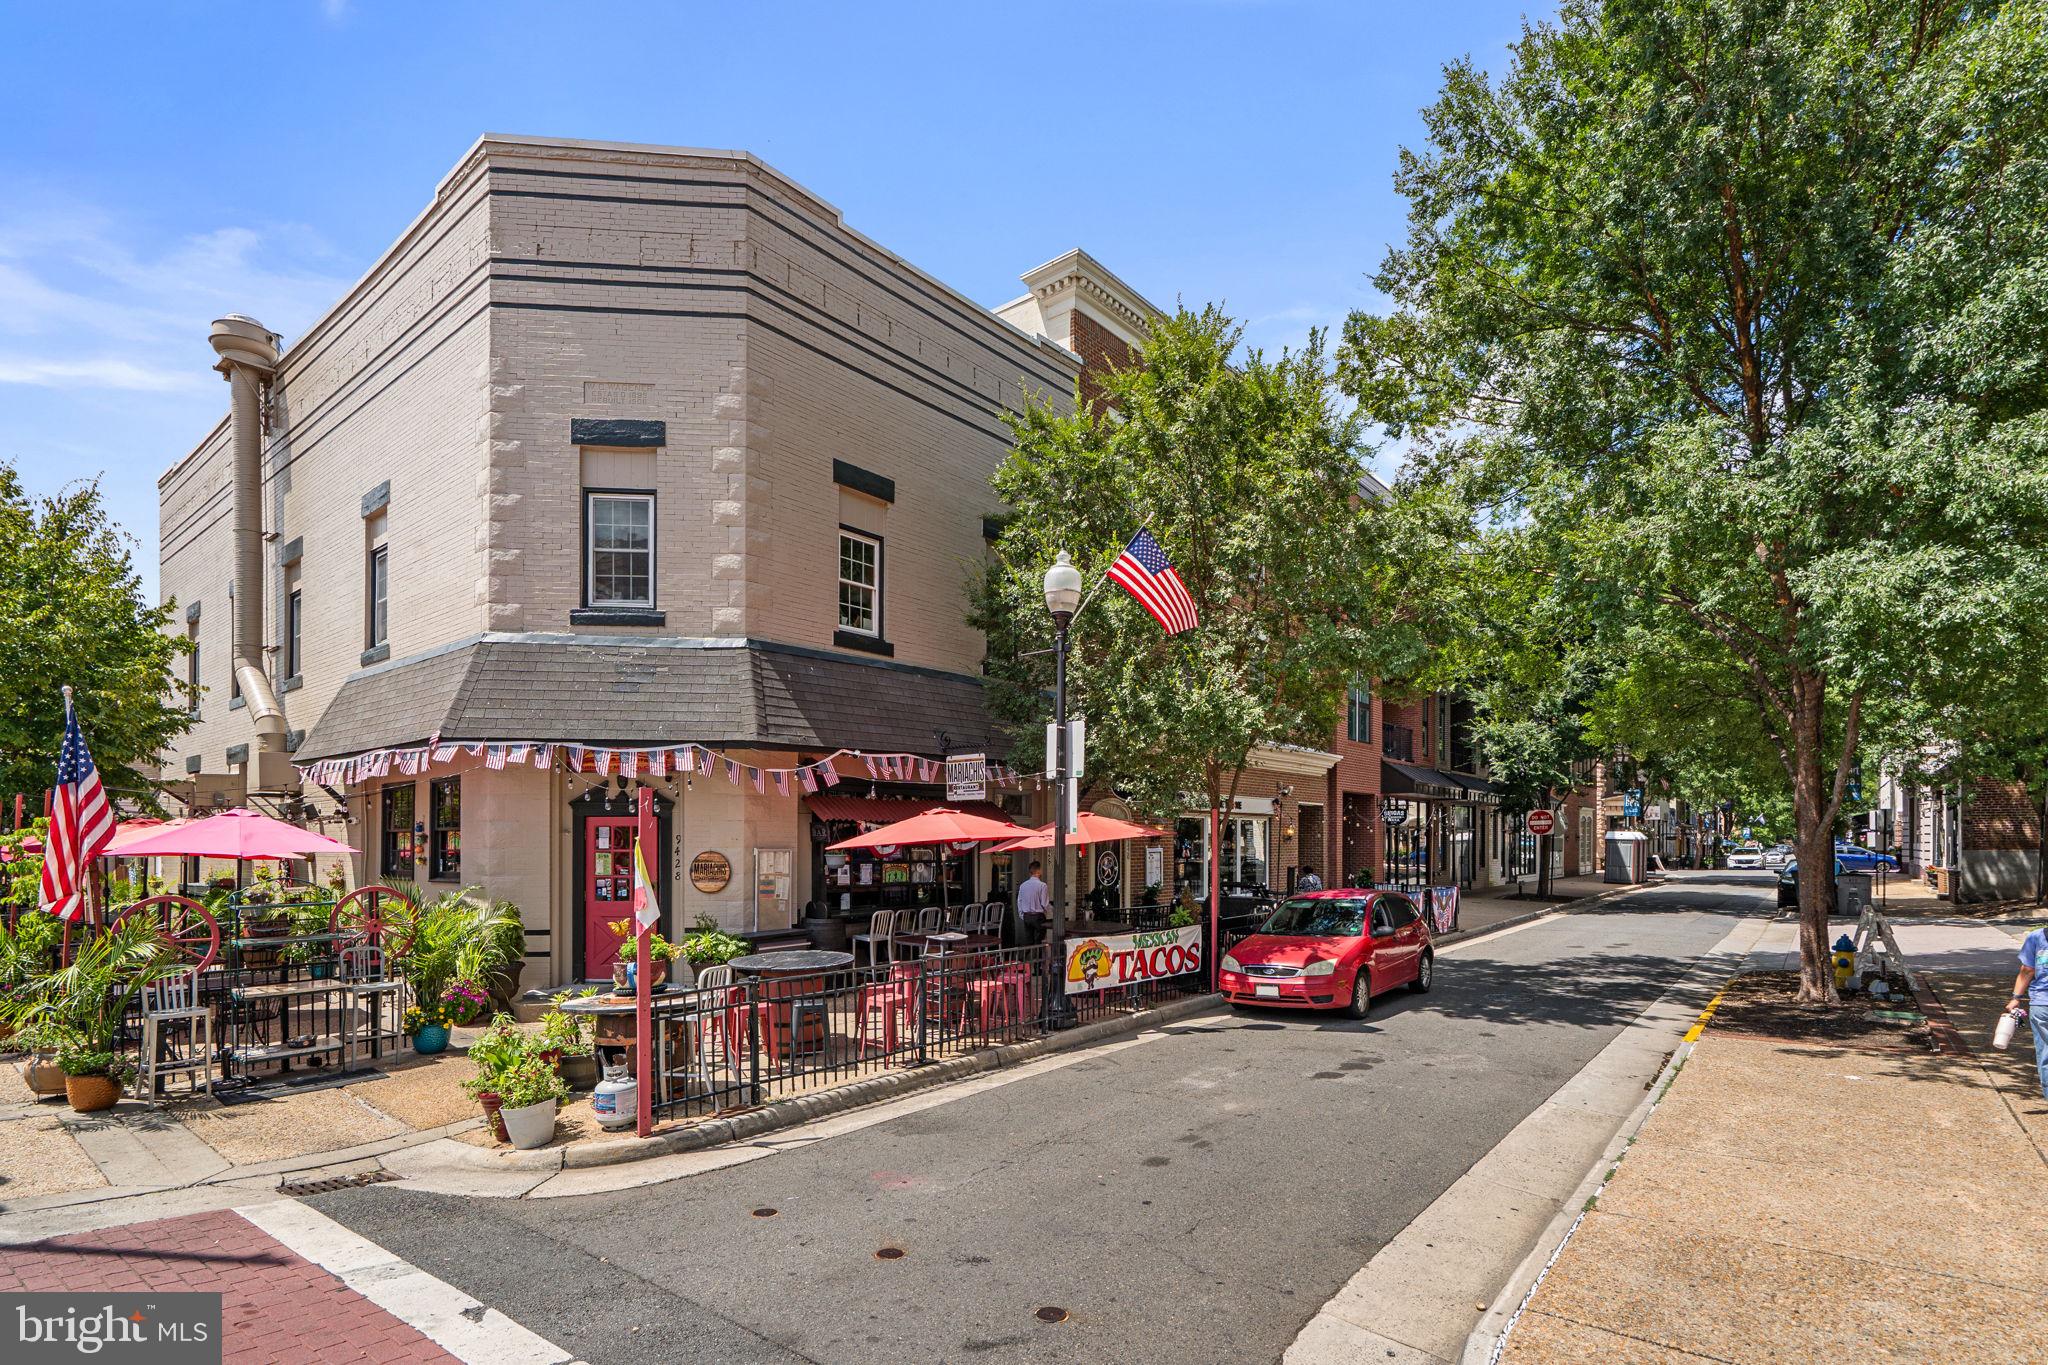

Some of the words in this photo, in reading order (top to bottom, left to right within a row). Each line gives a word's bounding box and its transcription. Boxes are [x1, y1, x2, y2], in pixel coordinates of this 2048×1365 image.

[948, 761, 984, 783] MARIACHIS
[1132, 929, 1180, 949] MEXICAN
[1111, 943, 1200, 983] TACOS
